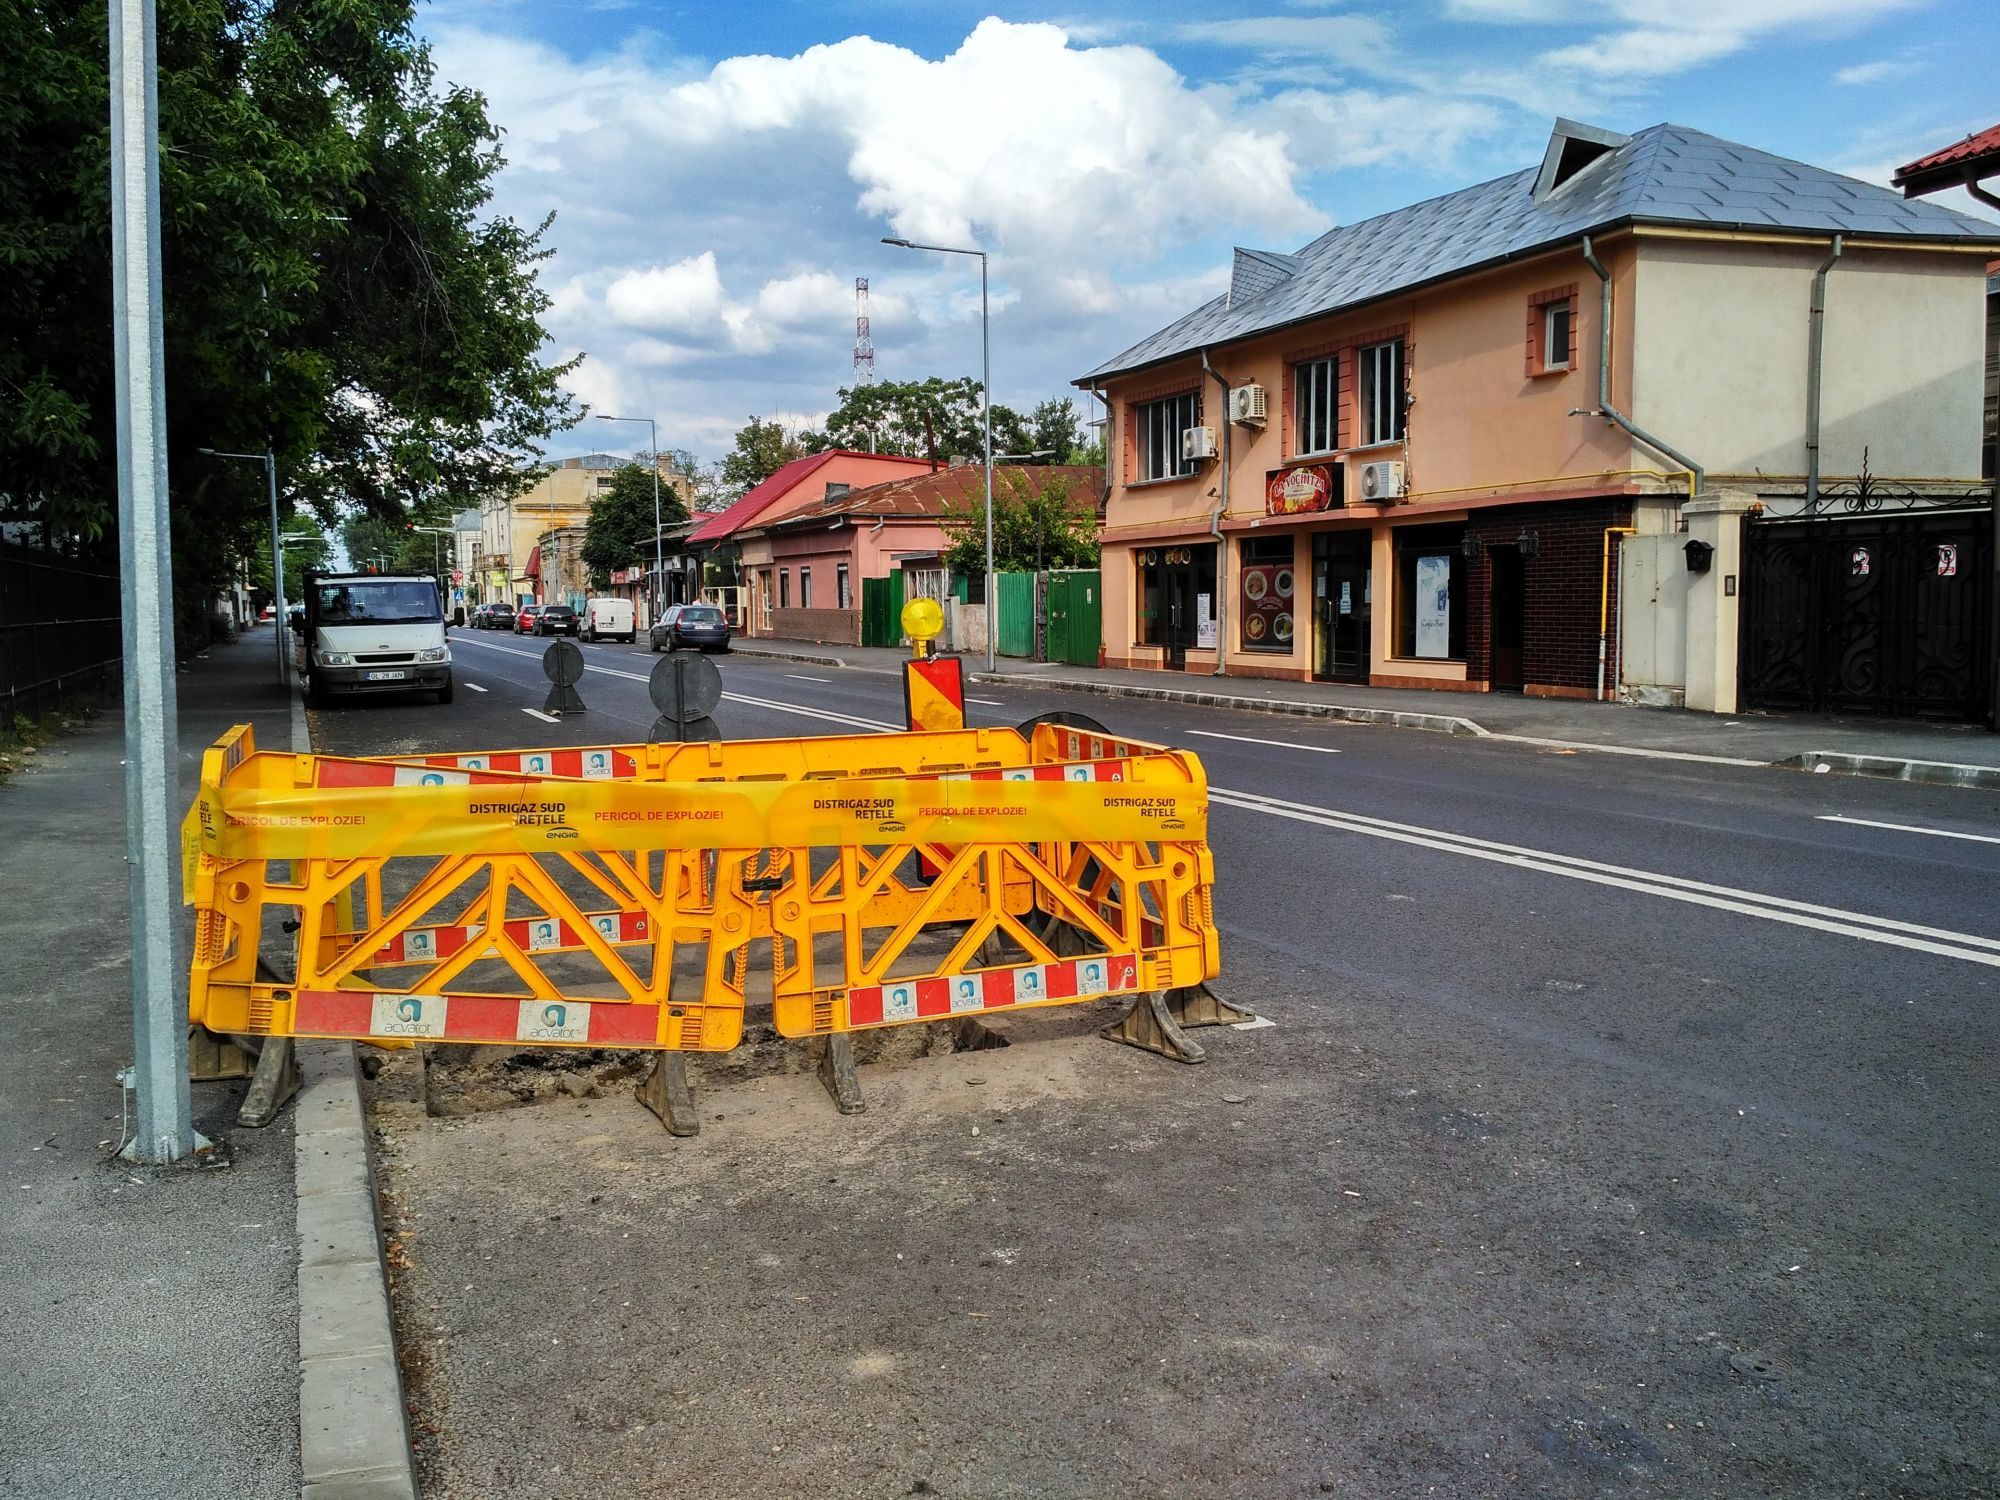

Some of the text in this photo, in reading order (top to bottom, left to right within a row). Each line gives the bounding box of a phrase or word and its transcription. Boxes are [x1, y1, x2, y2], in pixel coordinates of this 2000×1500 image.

[813, 799, 894, 809] DISTRIGAZ SUD
[1103, 798, 1176, 807] DISTRIGAZ SUD
[469, 802, 566, 814] DISTRIGAZ SUD
[918, 806, 1027, 816] PERICOL DE EXPLOZIE!
[279, 815, 297, 826] DE
[301, 815, 366, 826] EXPLOZIE!
[594, 810, 724, 821] PERICOL DE EXPLOZIE!
